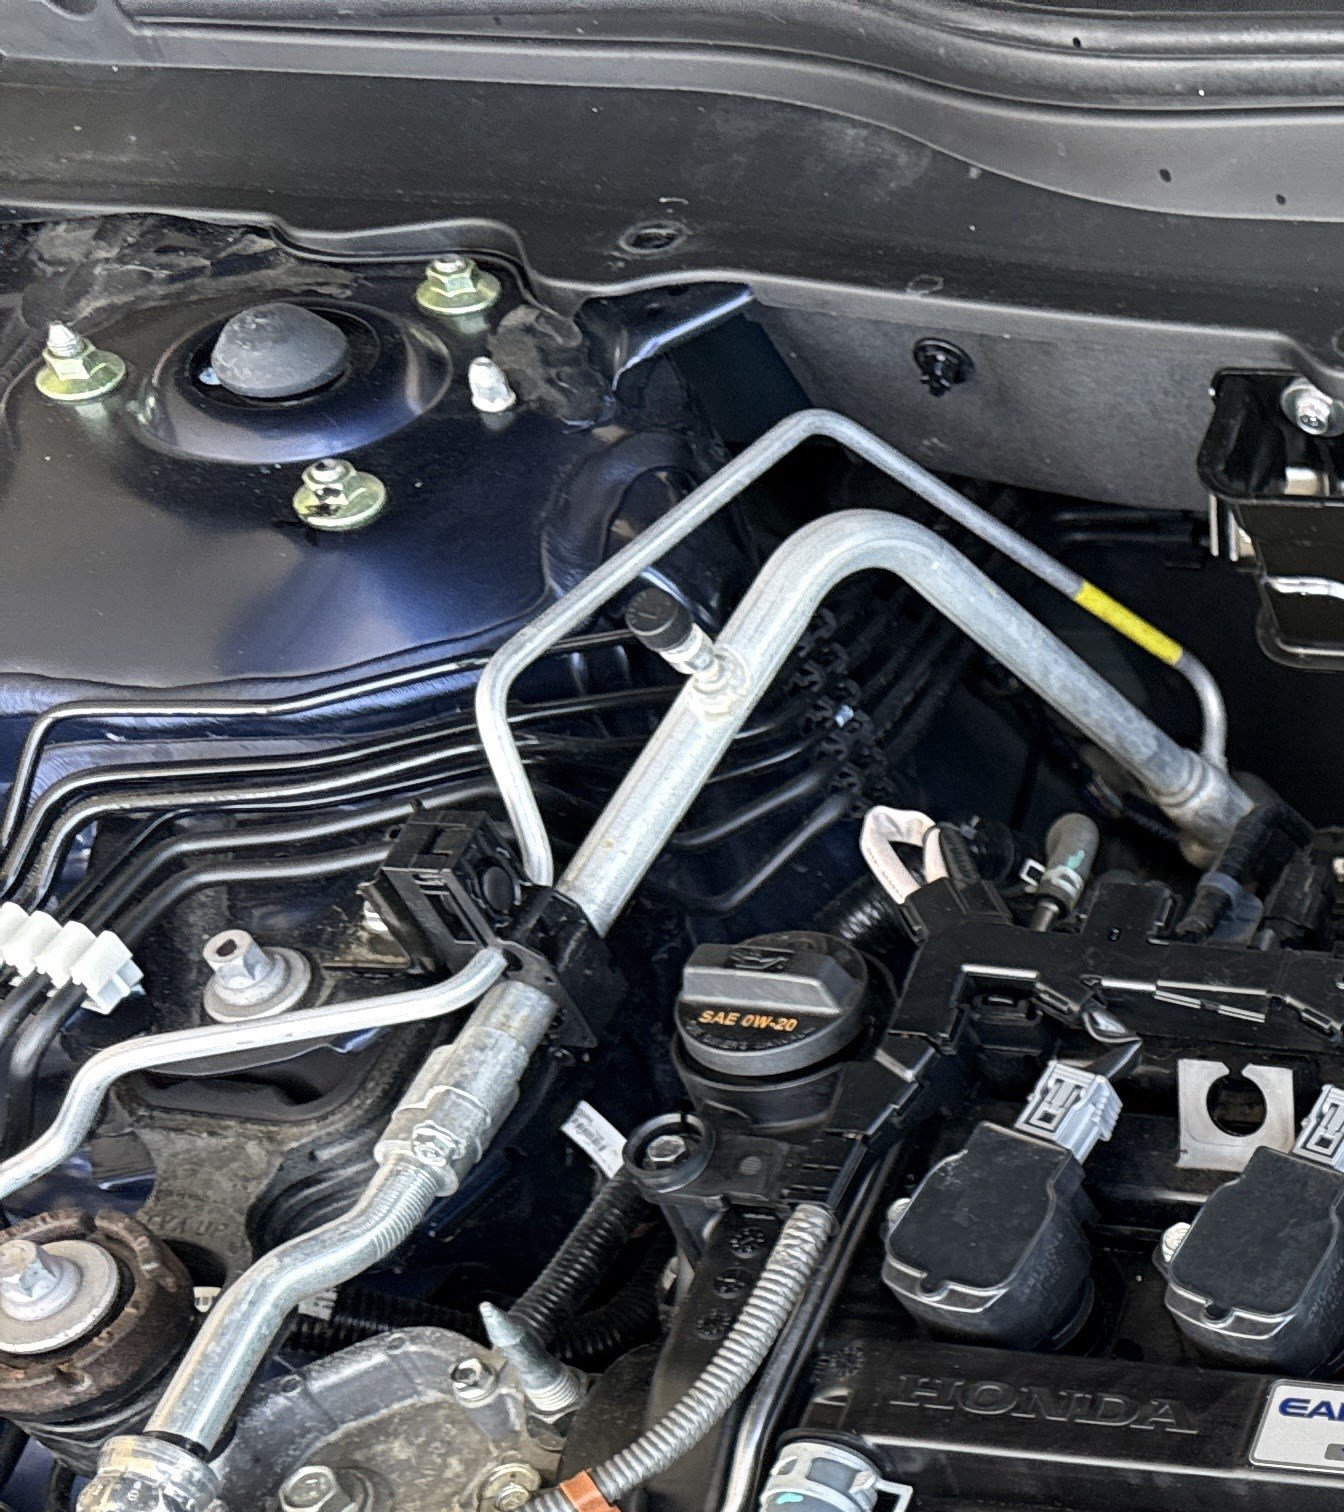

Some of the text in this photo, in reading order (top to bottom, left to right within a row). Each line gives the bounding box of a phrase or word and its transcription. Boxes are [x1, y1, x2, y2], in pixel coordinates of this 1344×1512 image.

[698, 1010, 798, 1032] SAE 0W-20
[889, 1374, 1198, 1434] HONDA
